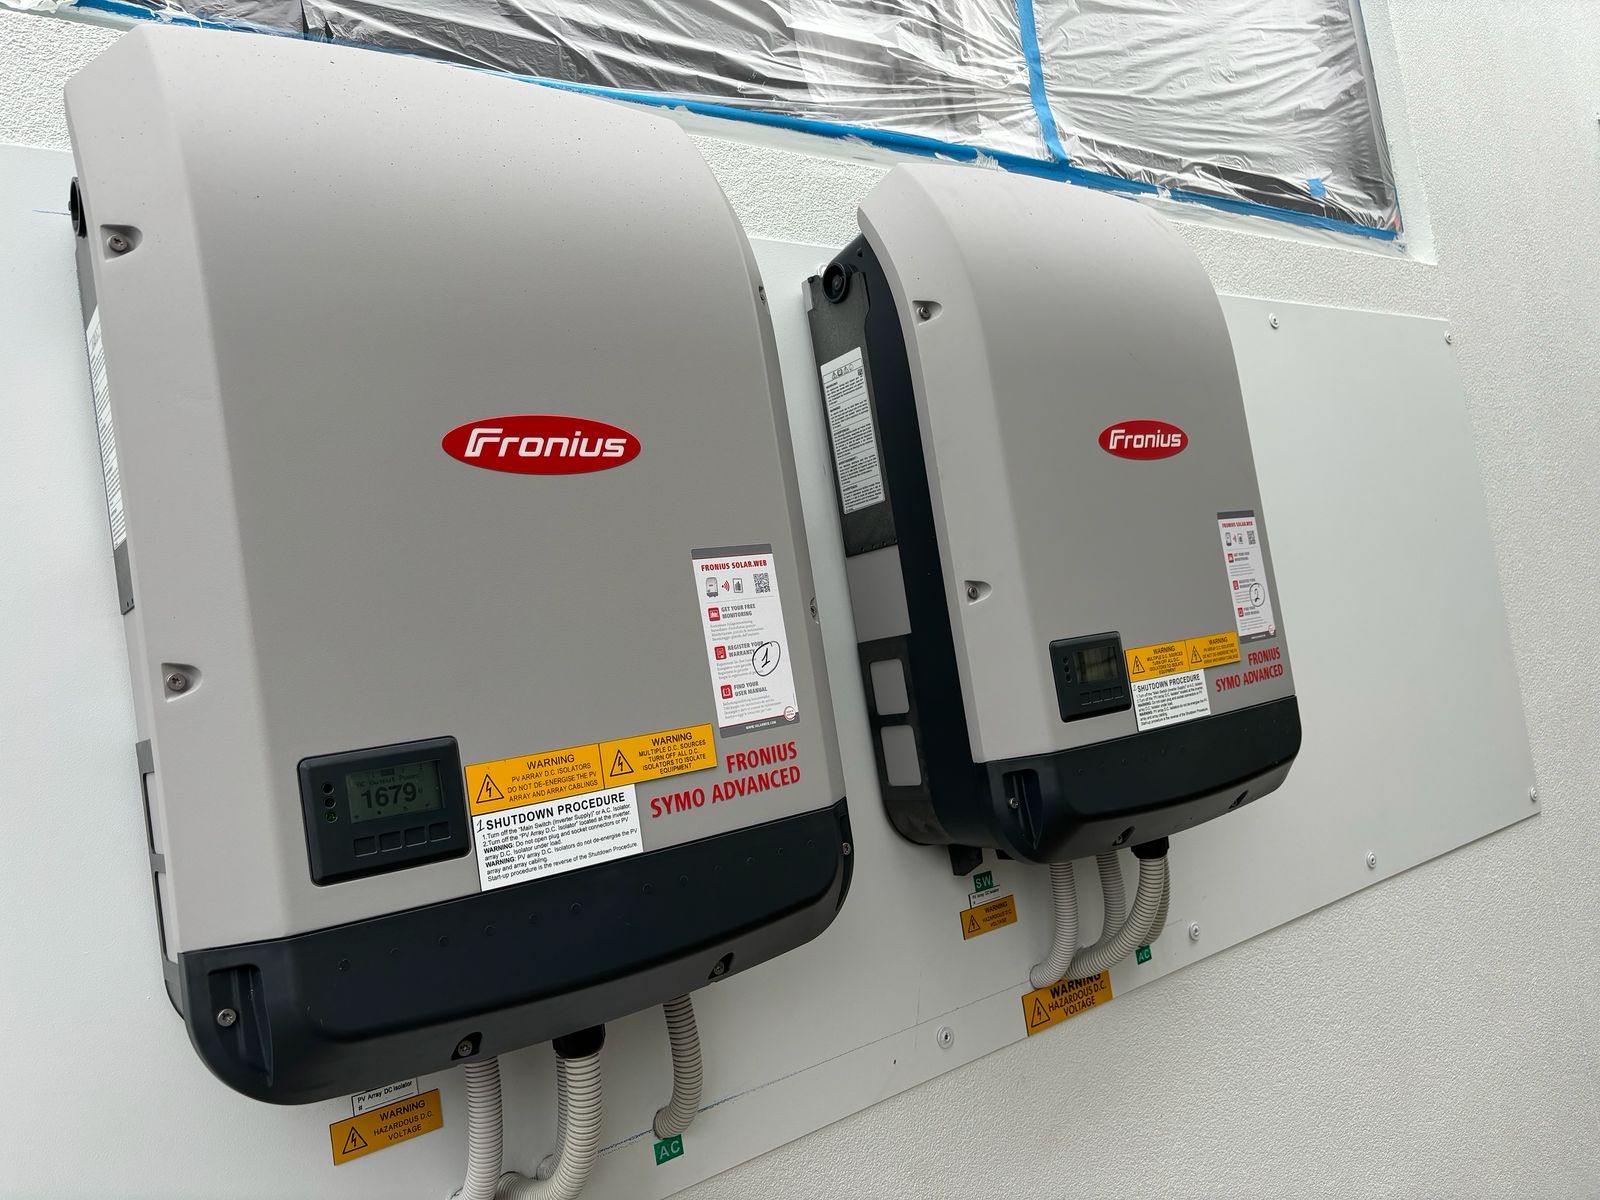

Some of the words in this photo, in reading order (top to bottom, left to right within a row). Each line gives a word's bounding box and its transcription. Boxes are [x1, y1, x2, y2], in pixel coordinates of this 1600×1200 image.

[464, 428, 627, 457] Fronius
[1109, 429, 1181, 449] Fronius
[701, 563, 730, 572] FRONIUS
[731, 560, 768, 569] SOLAR.WEB
[722, 611, 752, 619] MONITORING
[1153, 645, 1175, 654] WARNING
[1209, 637, 1228, 645] WARNING
[729, 649, 756, 657] WARRANTY
[1248, 647, 1280, 665] FRONIUS
[1137, 680, 1168, 692] SHUTDOWN
[1169, 674, 1200, 686] PROCEDURE
[1216, 675, 1240, 692] SYMO
[1243, 664, 1283, 685] ADVANCED
[748, 686, 768, 694] MANUAL
[639, 747, 666, 757] MULTIPLE
[680, 739, 706, 749] SOURCES
[651, 732, 692, 746] WARNING
[527, 754, 575, 770] WARNING
[643, 760, 674, 771] ISOLATORS
[684, 753, 706, 762] ISOLATE
[648, 754, 664, 762] TURN
[726, 741, 797, 773] FRONIUS
[521, 771, 543, 780] ARRAY
[557, 762, 591, 774] ISOLATORS
[659, 763, 692, 774] EQUIPMENT
[509, 793, 531, 802] ARRAY
[532, 790, 545, 798] AND
[547, 786, 567, 795] ARRAY
[568, 780, 598, 791] CABLINGS
[519, 783, 532, 791] NOT
[534, 775, 575, 788] DE-ENERGISE
[650, 788, 705, 818] SYMO
[712, 766, 800, 803] ADVANCED
[361, 782, 416, 808] 1679
[486, 807, 554, 830] SHUTDOWN
[557, 792, 625, 815] PROCEDURE
[475, 818, 486, 834] 1
[519, 824, 533, 832] "Main
[534, 820, 552, 829] Switch
[530, 829, 544, 838] Array
[579, 817, 597, 826] located
[484, 842, 515, 854] WARNING:
[534, 836, 547, 844] open
[548, 833, 560, 841] plug
[571, 826, 587, 834] socket
[588, 821, 614, 830] connectors
[485, 854, 500, 862] array
[513, 845, 532, 855] Isolator
[534, 842, 549, 850] under
[486, 856, 516, 868] WARNING:
[527, 852, 540, 860] array
[554, 842, 575, 852] Isolators
[593, 832, 621, 844] de-energise
[487, 868, 501, 876] array
[514, 862, 527, 870] array
[488, 872, 510, 883] Start-up
[510, 866, 537, 878] procedure
[553, 858, 572, 866] reverse
[588, 847, 612, 858] Shutdown
[976, 875, 990, 888] SW
[985, 901, 1008, 913] WARNING
[1138, 948, 1150, 962] AC
[1050, 973, 1101, 999] WARNING
[1049, 987, 1092, 1012] HAZARDOUS
[1094, 980, 1107, 993] D.C.
[1064, 996, 1096, 1016] VOLTAGE
[368, 1092, 382, 1101] Array
[384, 1086, 393, 1094] DC
[380, 1100, 426, 1121] WARNING
[374, 1115, 419, 1136] HAZARDOUS
[388, 1124, 422, 1141] VOLTAGE
[659, 1140, 680, 1160] AC
